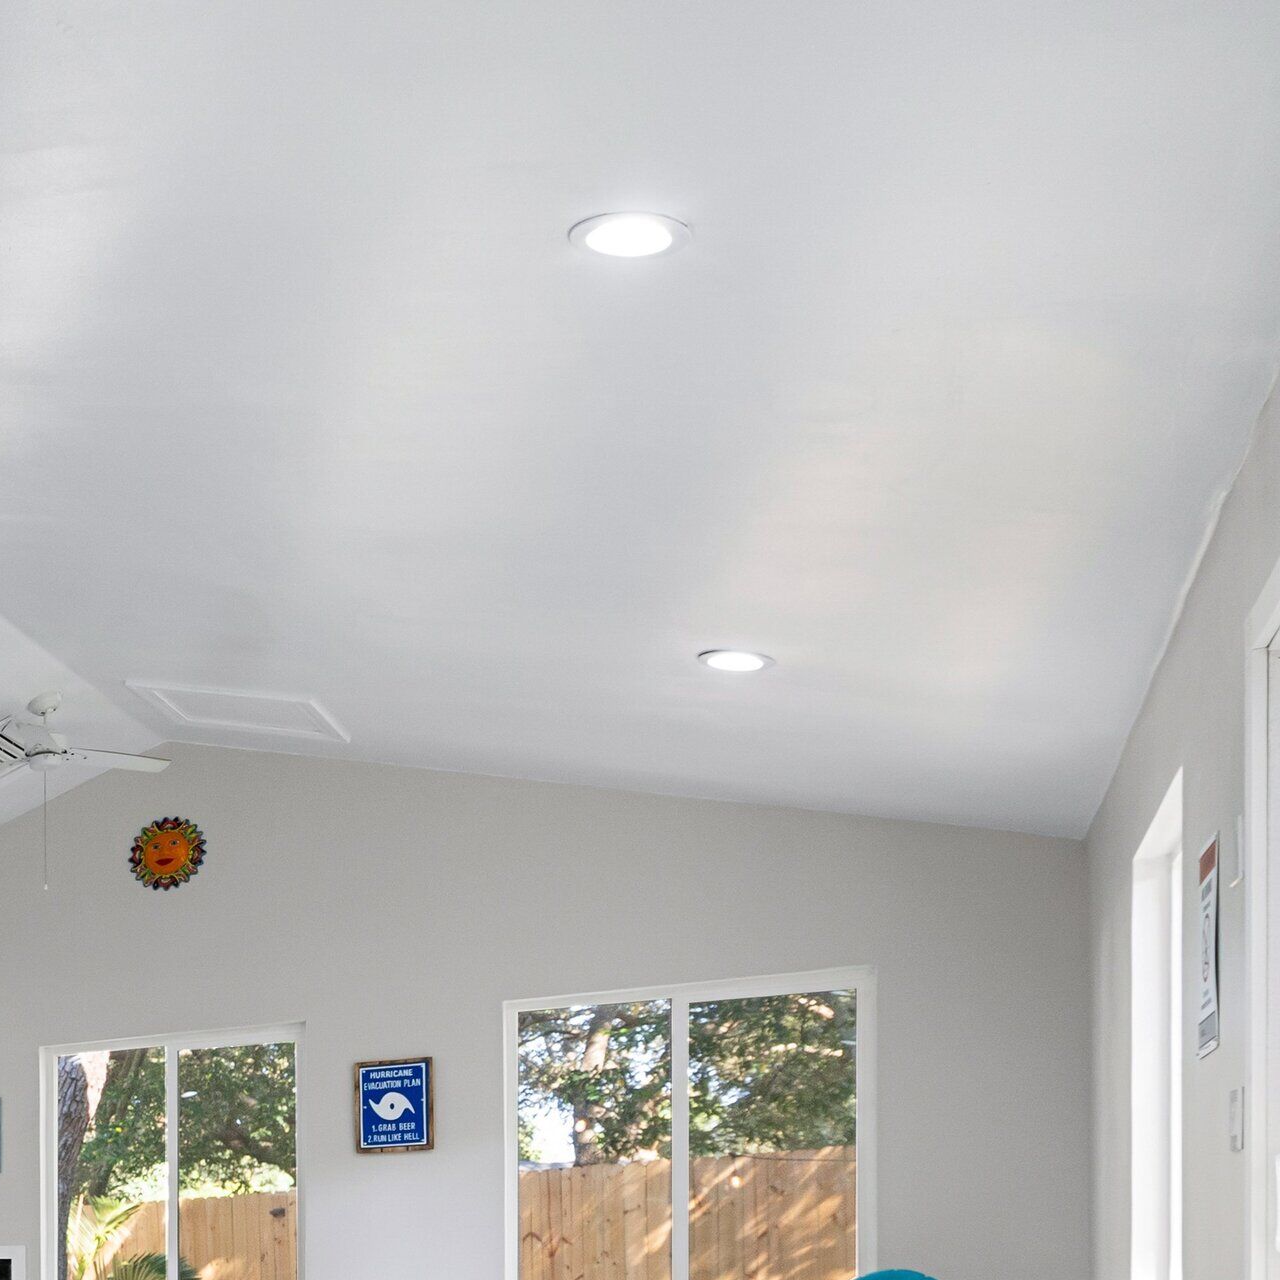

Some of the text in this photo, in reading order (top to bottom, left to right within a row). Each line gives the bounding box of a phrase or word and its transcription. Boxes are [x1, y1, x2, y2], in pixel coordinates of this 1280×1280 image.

[370, 1069, 414, 1079] HURRICANE
[363, 1078, 421, 1091] EVACUATION PLAN
[398, 1122, 416, 1131] BEER
[387, 1132, 402, 1142] LIKE
[403, 1132, 420, 1141] HELL
